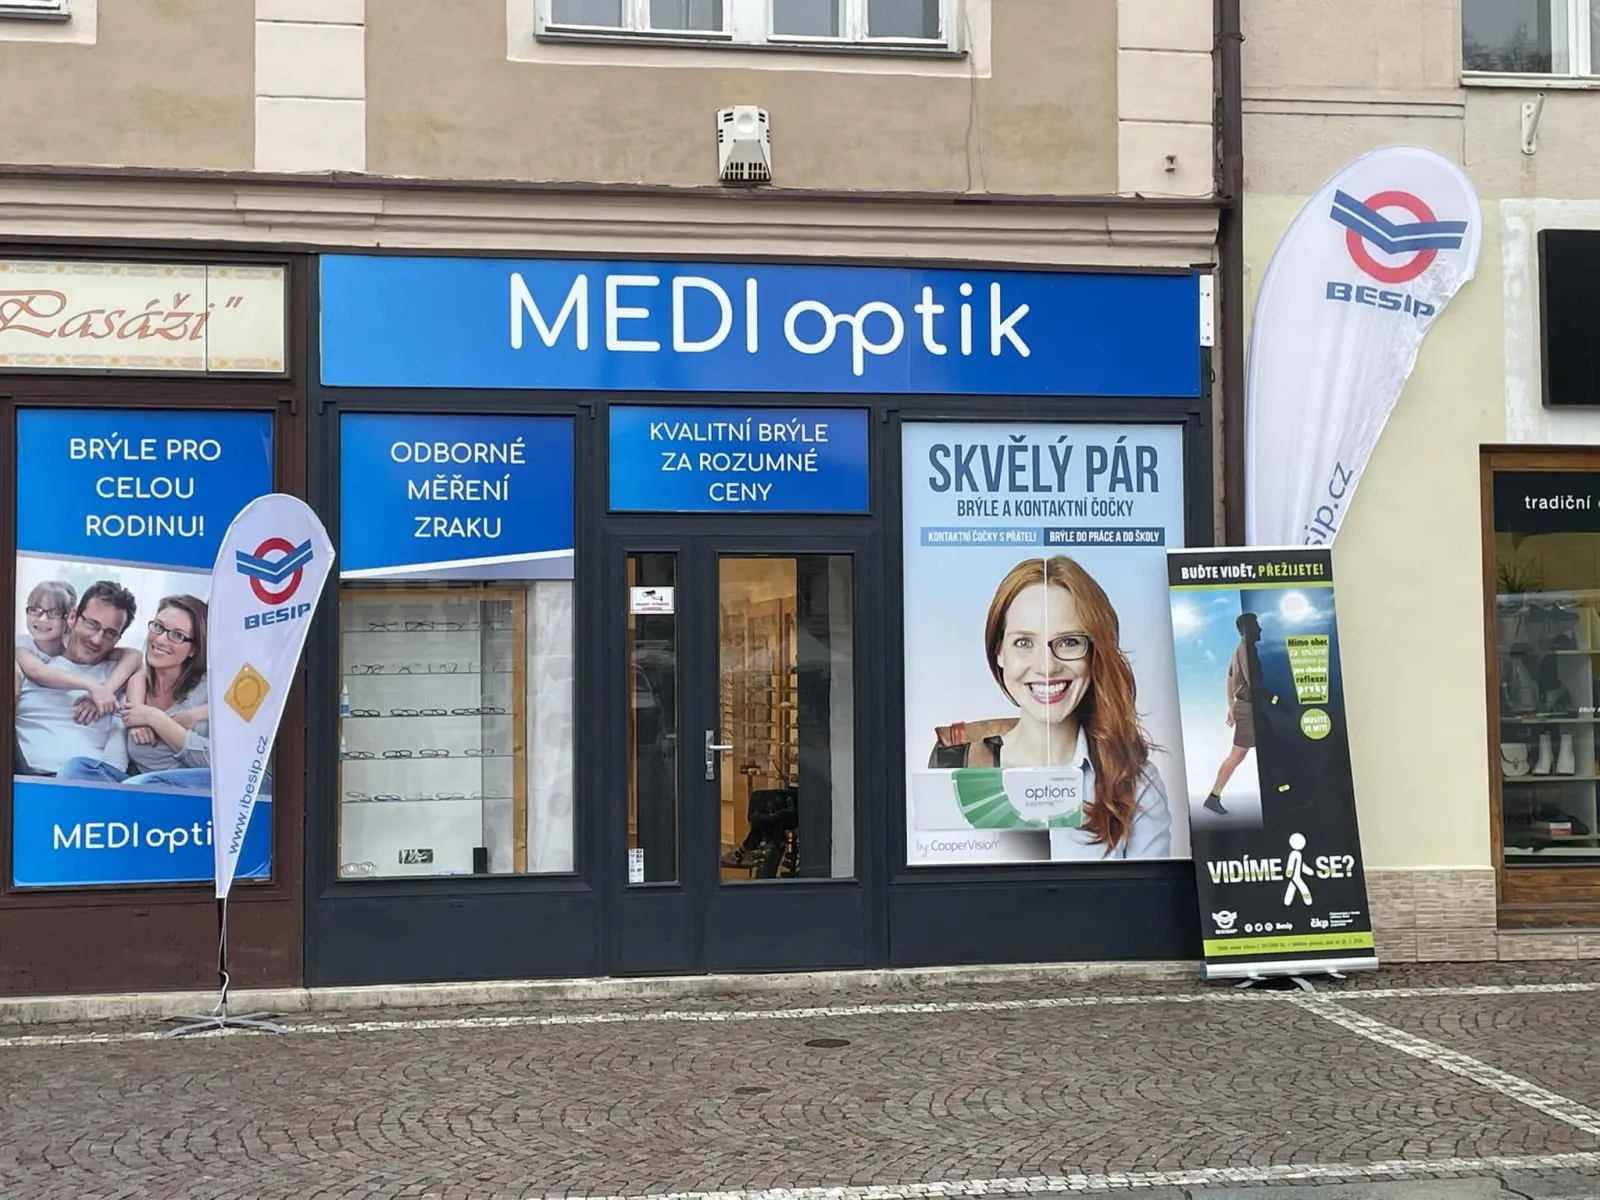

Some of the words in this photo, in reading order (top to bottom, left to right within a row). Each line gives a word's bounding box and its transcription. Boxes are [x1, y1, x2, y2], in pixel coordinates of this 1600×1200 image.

[1326, 281, 1435, 318] BESIP
[510, 272, 758, 353] MEDI
[784, 281, 1030, 376] optik
[650, 417, 752, 443] KVALITNÍ
[758, 418, 828, 443] BRÝLE
[69, 431, 157, 461] BRÝLE
[166, 439, 221, 461] PRO
[390, 437, 526, 465] ODBORNÉ
[661, 453, 692, 472] ZA
[699, 447, 818, 473] ROZUMNÉ
[928, 435, 1073, 493] SKVĚLÝ
[1086, 435, 1160, 494] PÁR
[96, 476, 195, 499] CELOU
[407, 474, 509, 502] MĚŘENÍ
[709, 482, 773, 502] CENY
[957, 497, 1000, 517] BRÝLE
[1002, 500, 1012, 517] A
[1014, 496, 1088, 517] KONTAKTNÍ
[1090, 495, 1134, 517] ČOČKY
[1525, 495, 1591, 509] tradiční
[86, 515, 204, 537] RODINU!
[413, 517, 502, 539] ZRAKU
[928, 528, 970, 542] KONTAKTNÍ
[972, 528, 997, 542] ČOČKY
[999, 530, 1005, 542] S
[1006, 527, 1037, 542] PŘÁTELI
[1049, 528, 1075, 542] BRÝLE
[1076, 531, 1088, 542] DO
[1090, 528, 1113, 542] PRÁCE
[1115, 531, 1121, 542] A
[1123, 531, 1134, 542] DO
[1135, 527, 1160, 542] ŠKOLY
[1181, 565, 1218, 580] BUĎTE
[1221, 563, 1256, 579] VIDĚT,
[1258, 562, 1324, 577] PŘEŽIJETE!
[244, 602, 311, 630] BESIP
[1287, 639, 1309, 647] Mimo
[229, 735, 268, 855] www.ibesip.cz
[1025, 785, 1076, 801] options
[53, 823, 138, 849] MEDI
[146, 820, 212, 854] opti
[916, 839, 928, 858] by
[930, 840, 998, 853] CooperVision
[1207, 854, 1284, 884] VIDÍME
[1315, 855, 1355, 880] SE?
